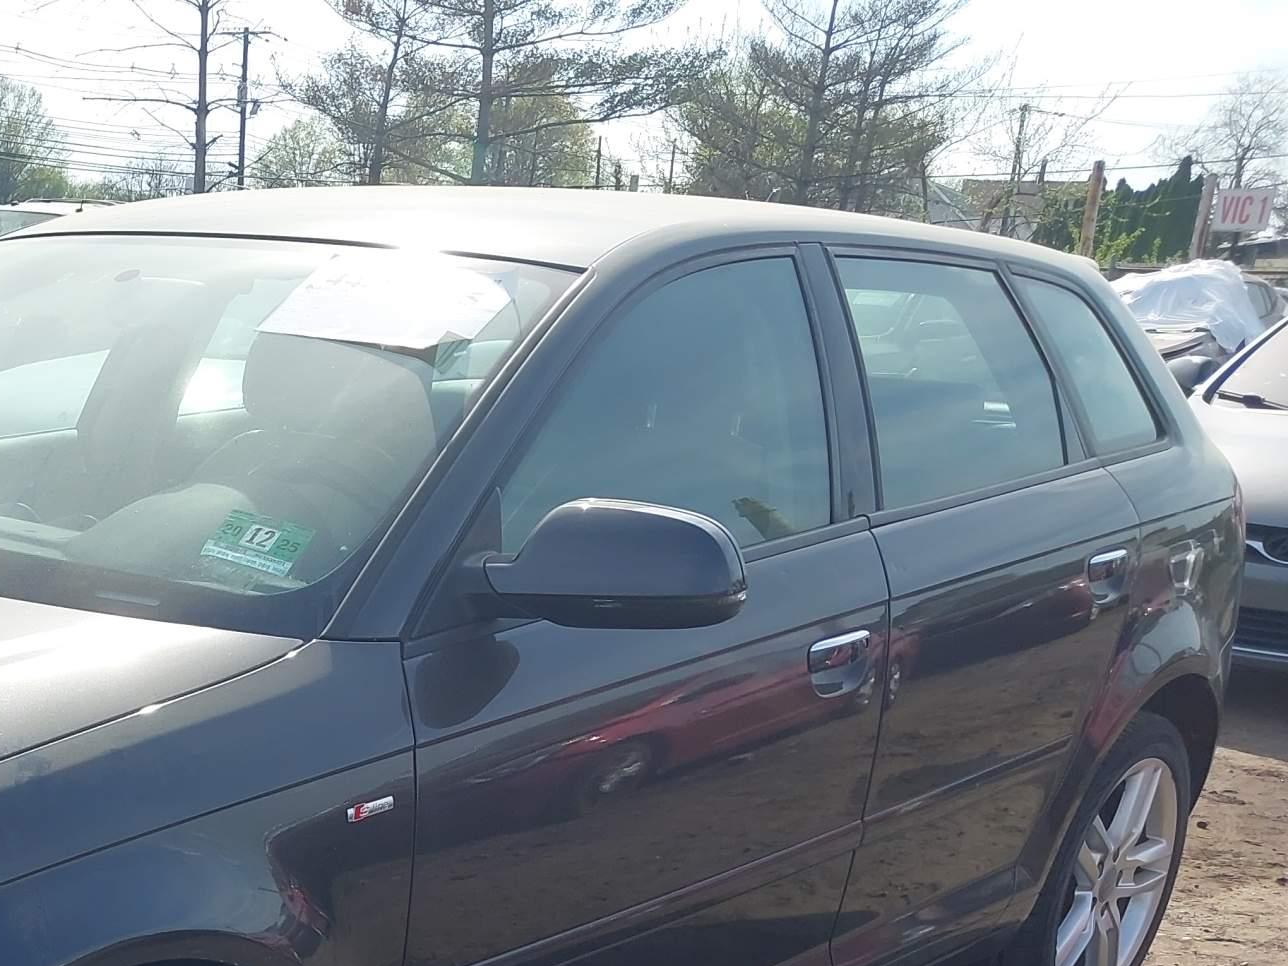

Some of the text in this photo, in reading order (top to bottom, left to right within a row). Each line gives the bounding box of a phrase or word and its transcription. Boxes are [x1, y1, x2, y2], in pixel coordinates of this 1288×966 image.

[1220, 195, 1269, 225] VIC 1
[222, 523, 301, 553] 20 12 25
